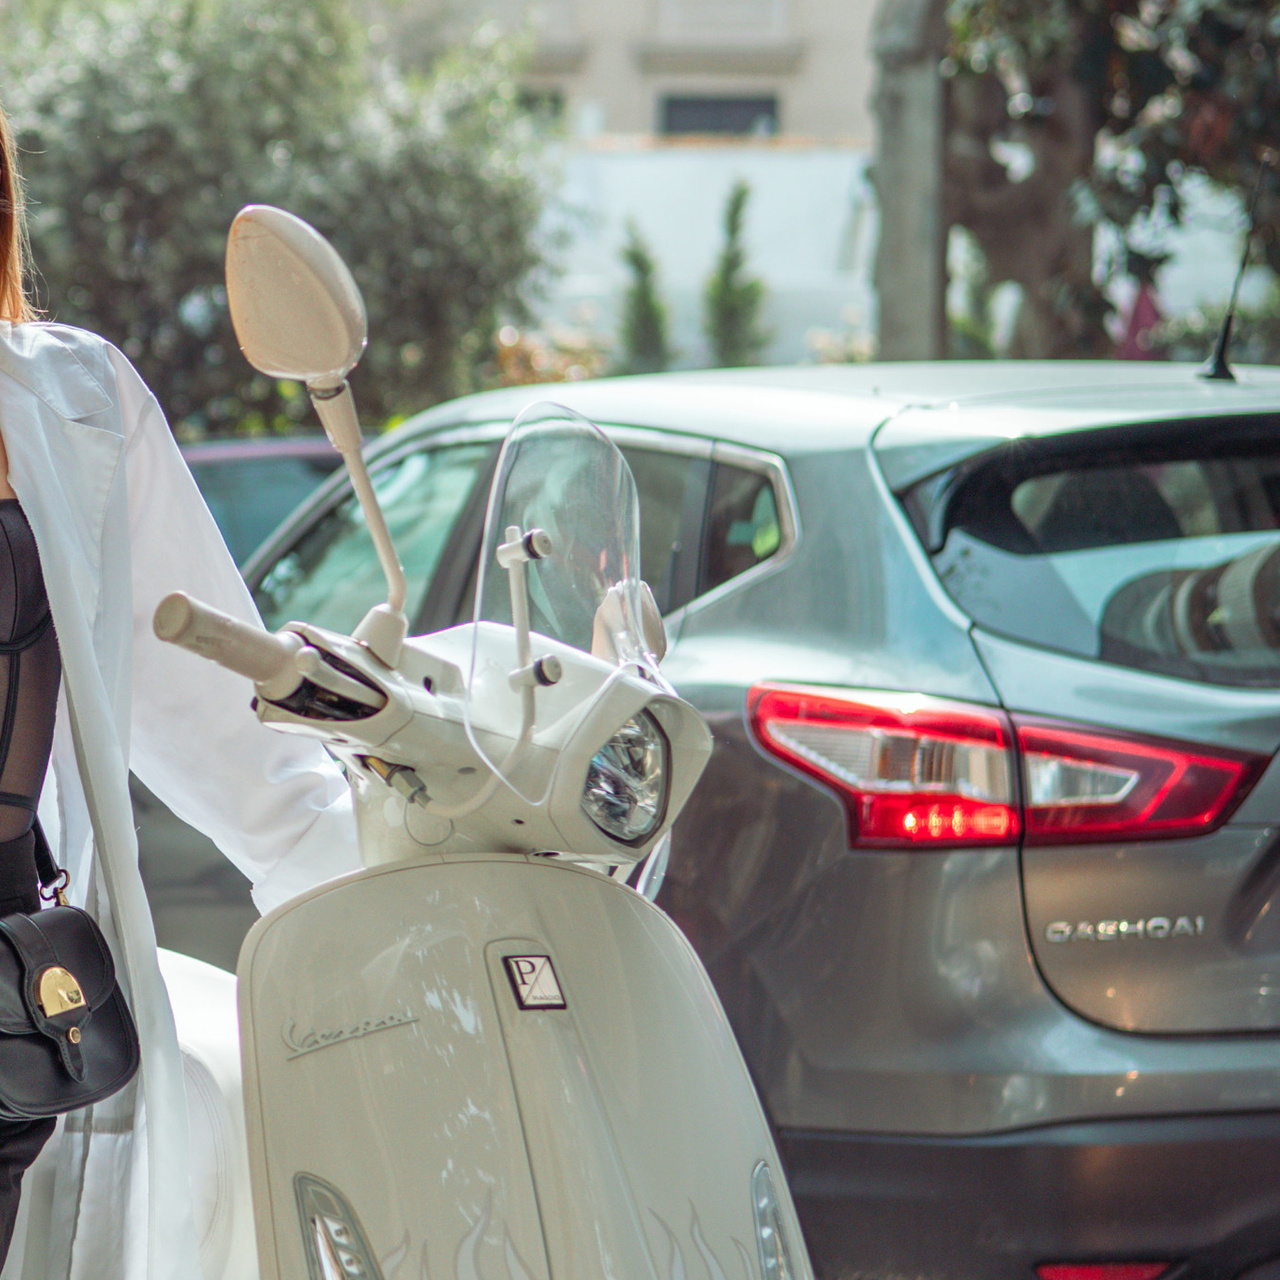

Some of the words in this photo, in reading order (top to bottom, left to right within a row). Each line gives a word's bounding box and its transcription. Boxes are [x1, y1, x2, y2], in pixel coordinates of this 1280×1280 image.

[1045, 915, 1205, 943] QASHQAI
[512, 959, 536, 986] P
[280, 1014, 420, 1062] Vespa
